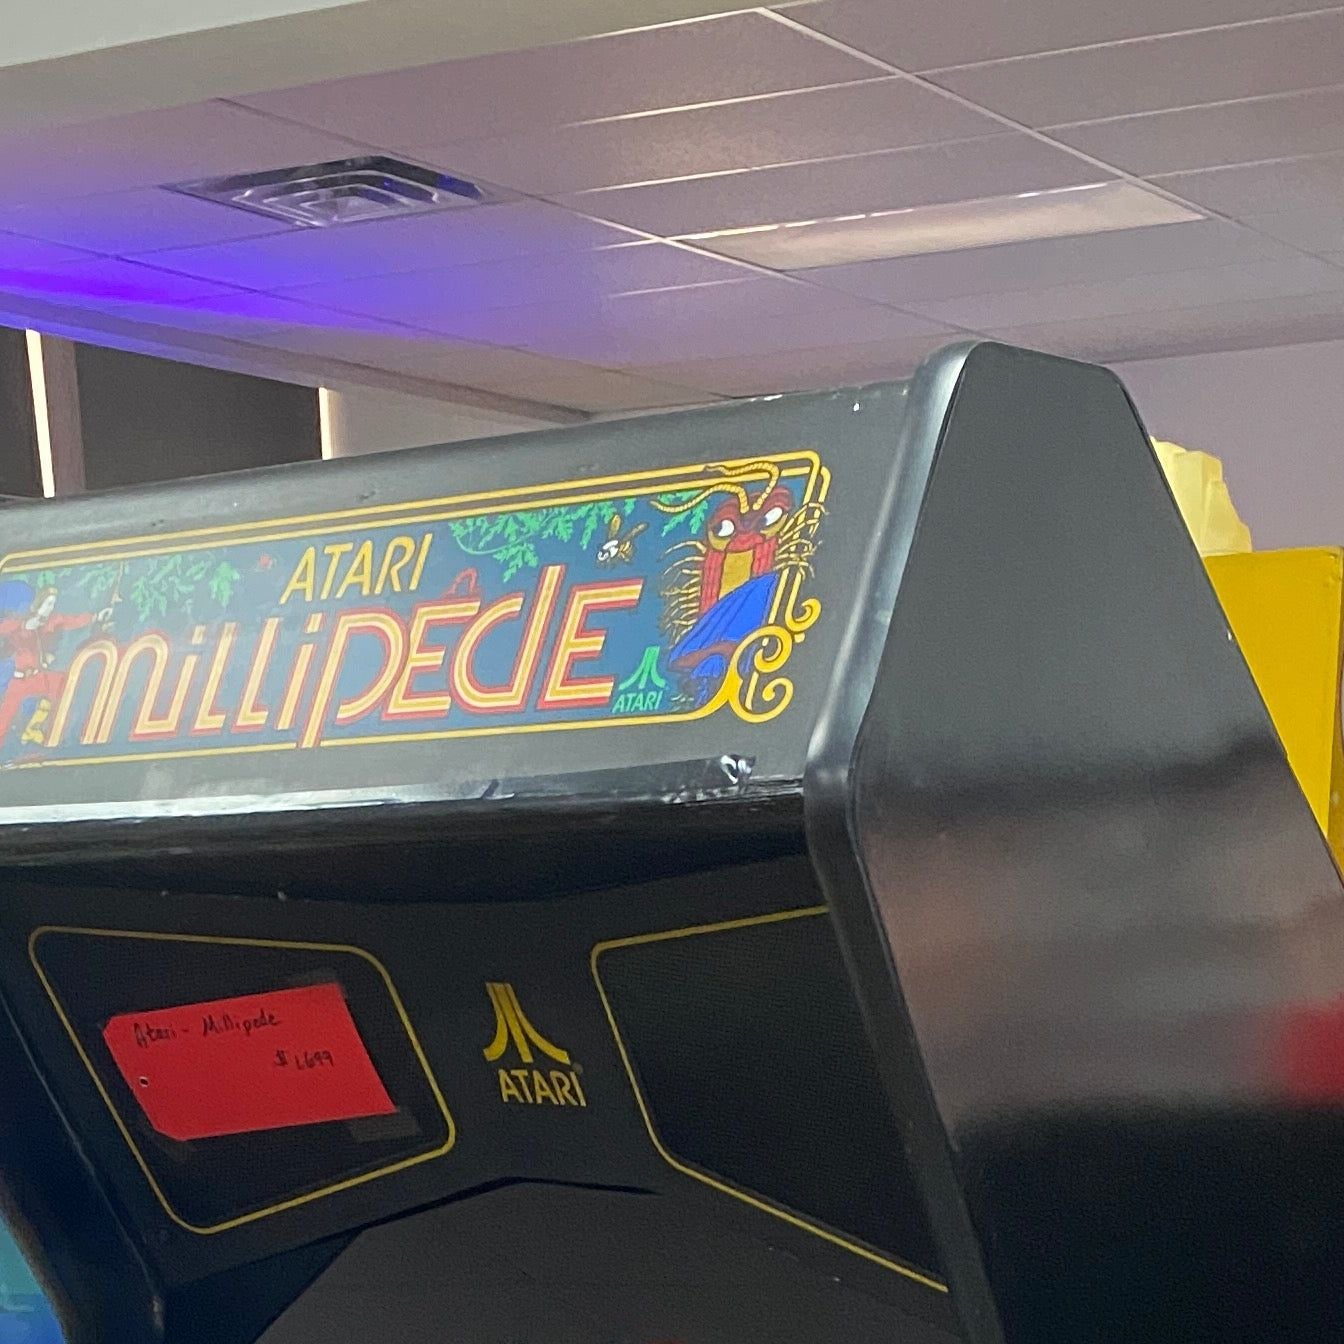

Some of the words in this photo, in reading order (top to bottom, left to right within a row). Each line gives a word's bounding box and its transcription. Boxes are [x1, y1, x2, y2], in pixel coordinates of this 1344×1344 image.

[280, 534, 432, 604] ATARI
[612, 691, 663, 713] ATARI
[497, 1070, 587, 1107] ATARI
